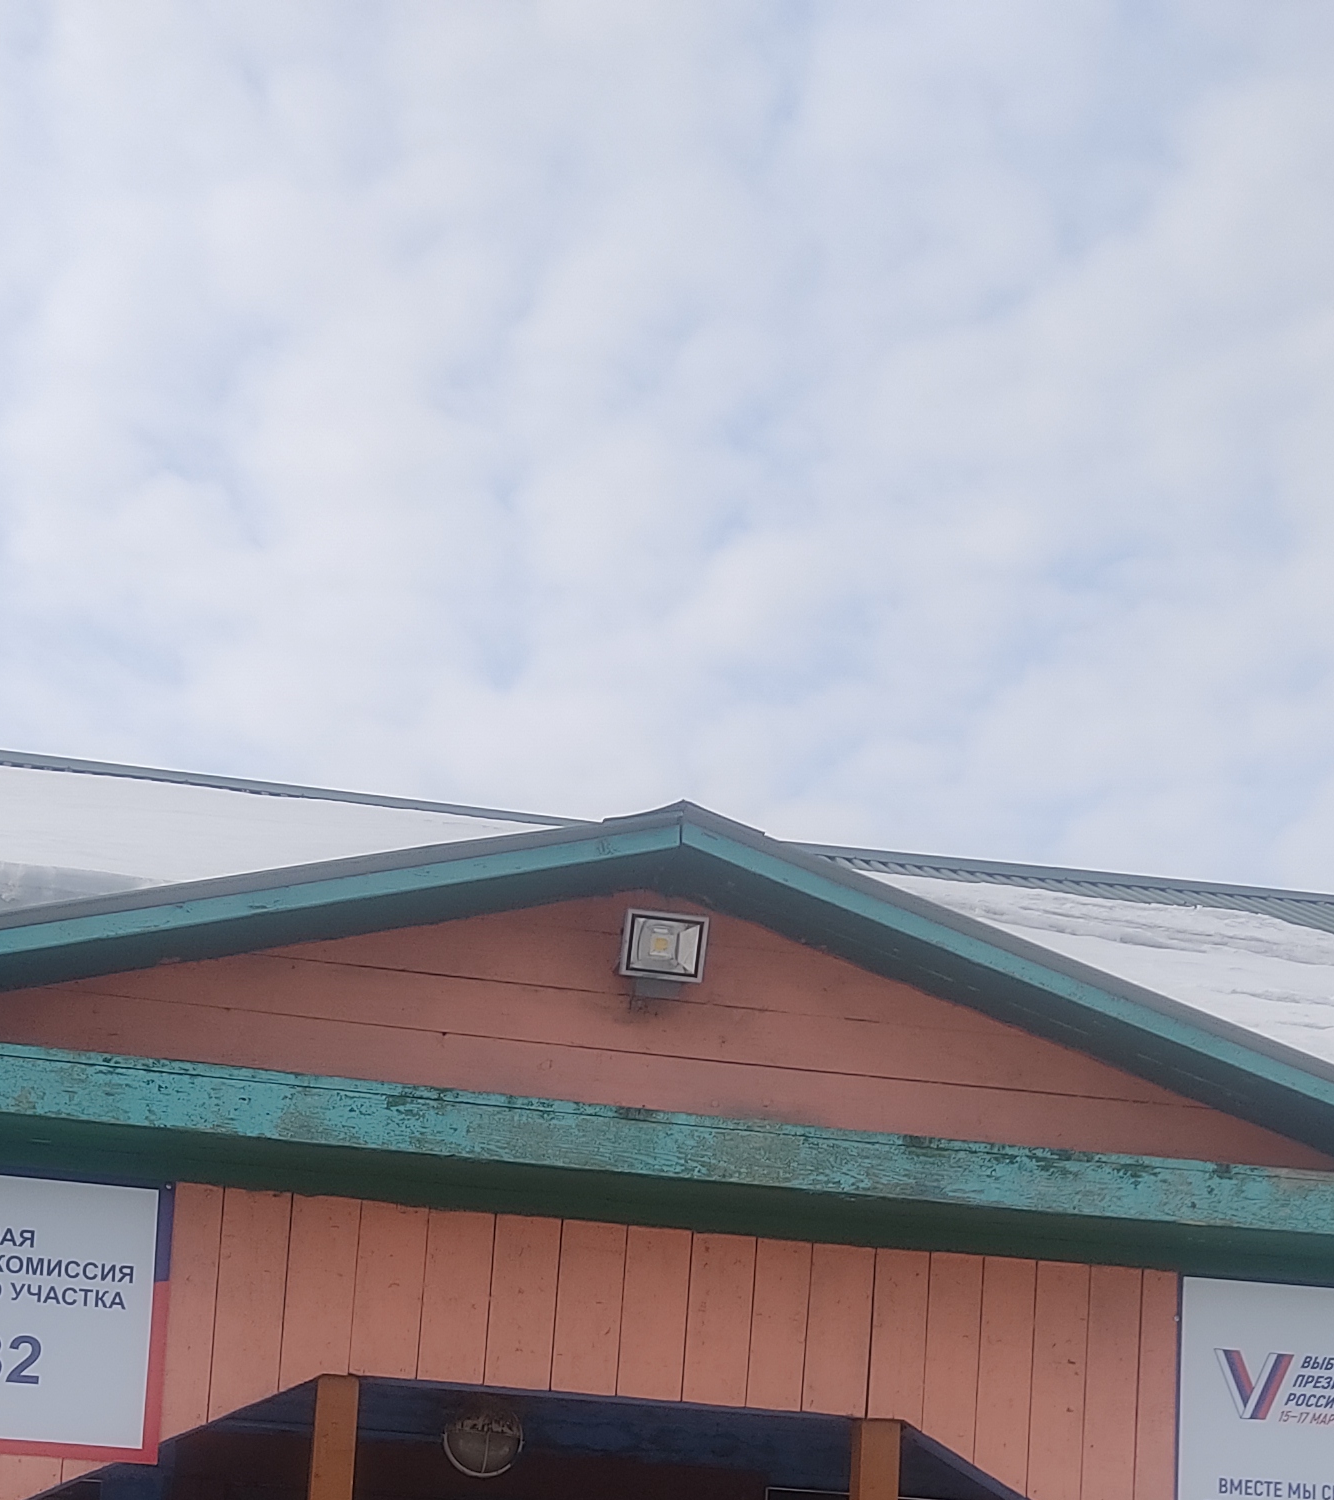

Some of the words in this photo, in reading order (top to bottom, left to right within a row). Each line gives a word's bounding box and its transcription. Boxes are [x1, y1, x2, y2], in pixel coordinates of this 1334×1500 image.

[11, 1283, 126, 1310] УЧАСТКА
[1218, 1477, 1283, 1498] ВМЕСТЕ
[1288, 1481, 1316, 1500] МЫ
